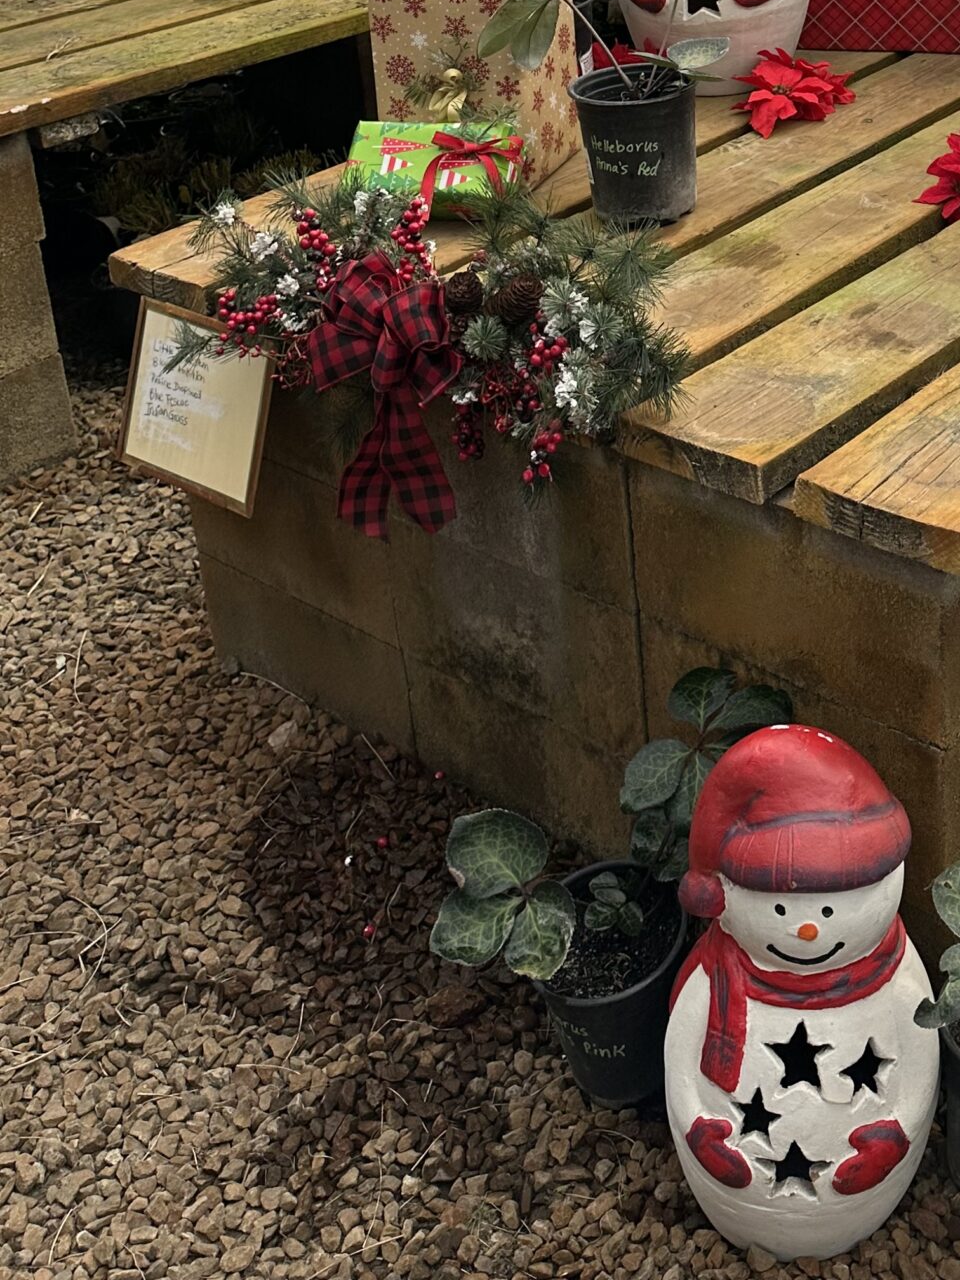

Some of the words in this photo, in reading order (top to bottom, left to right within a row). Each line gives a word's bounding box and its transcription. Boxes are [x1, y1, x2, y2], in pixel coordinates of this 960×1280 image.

[591, 135, 659, 153] Helleborus
[596, 156, 629, 175] Anna's
[637, 159, 661, 176] Red
